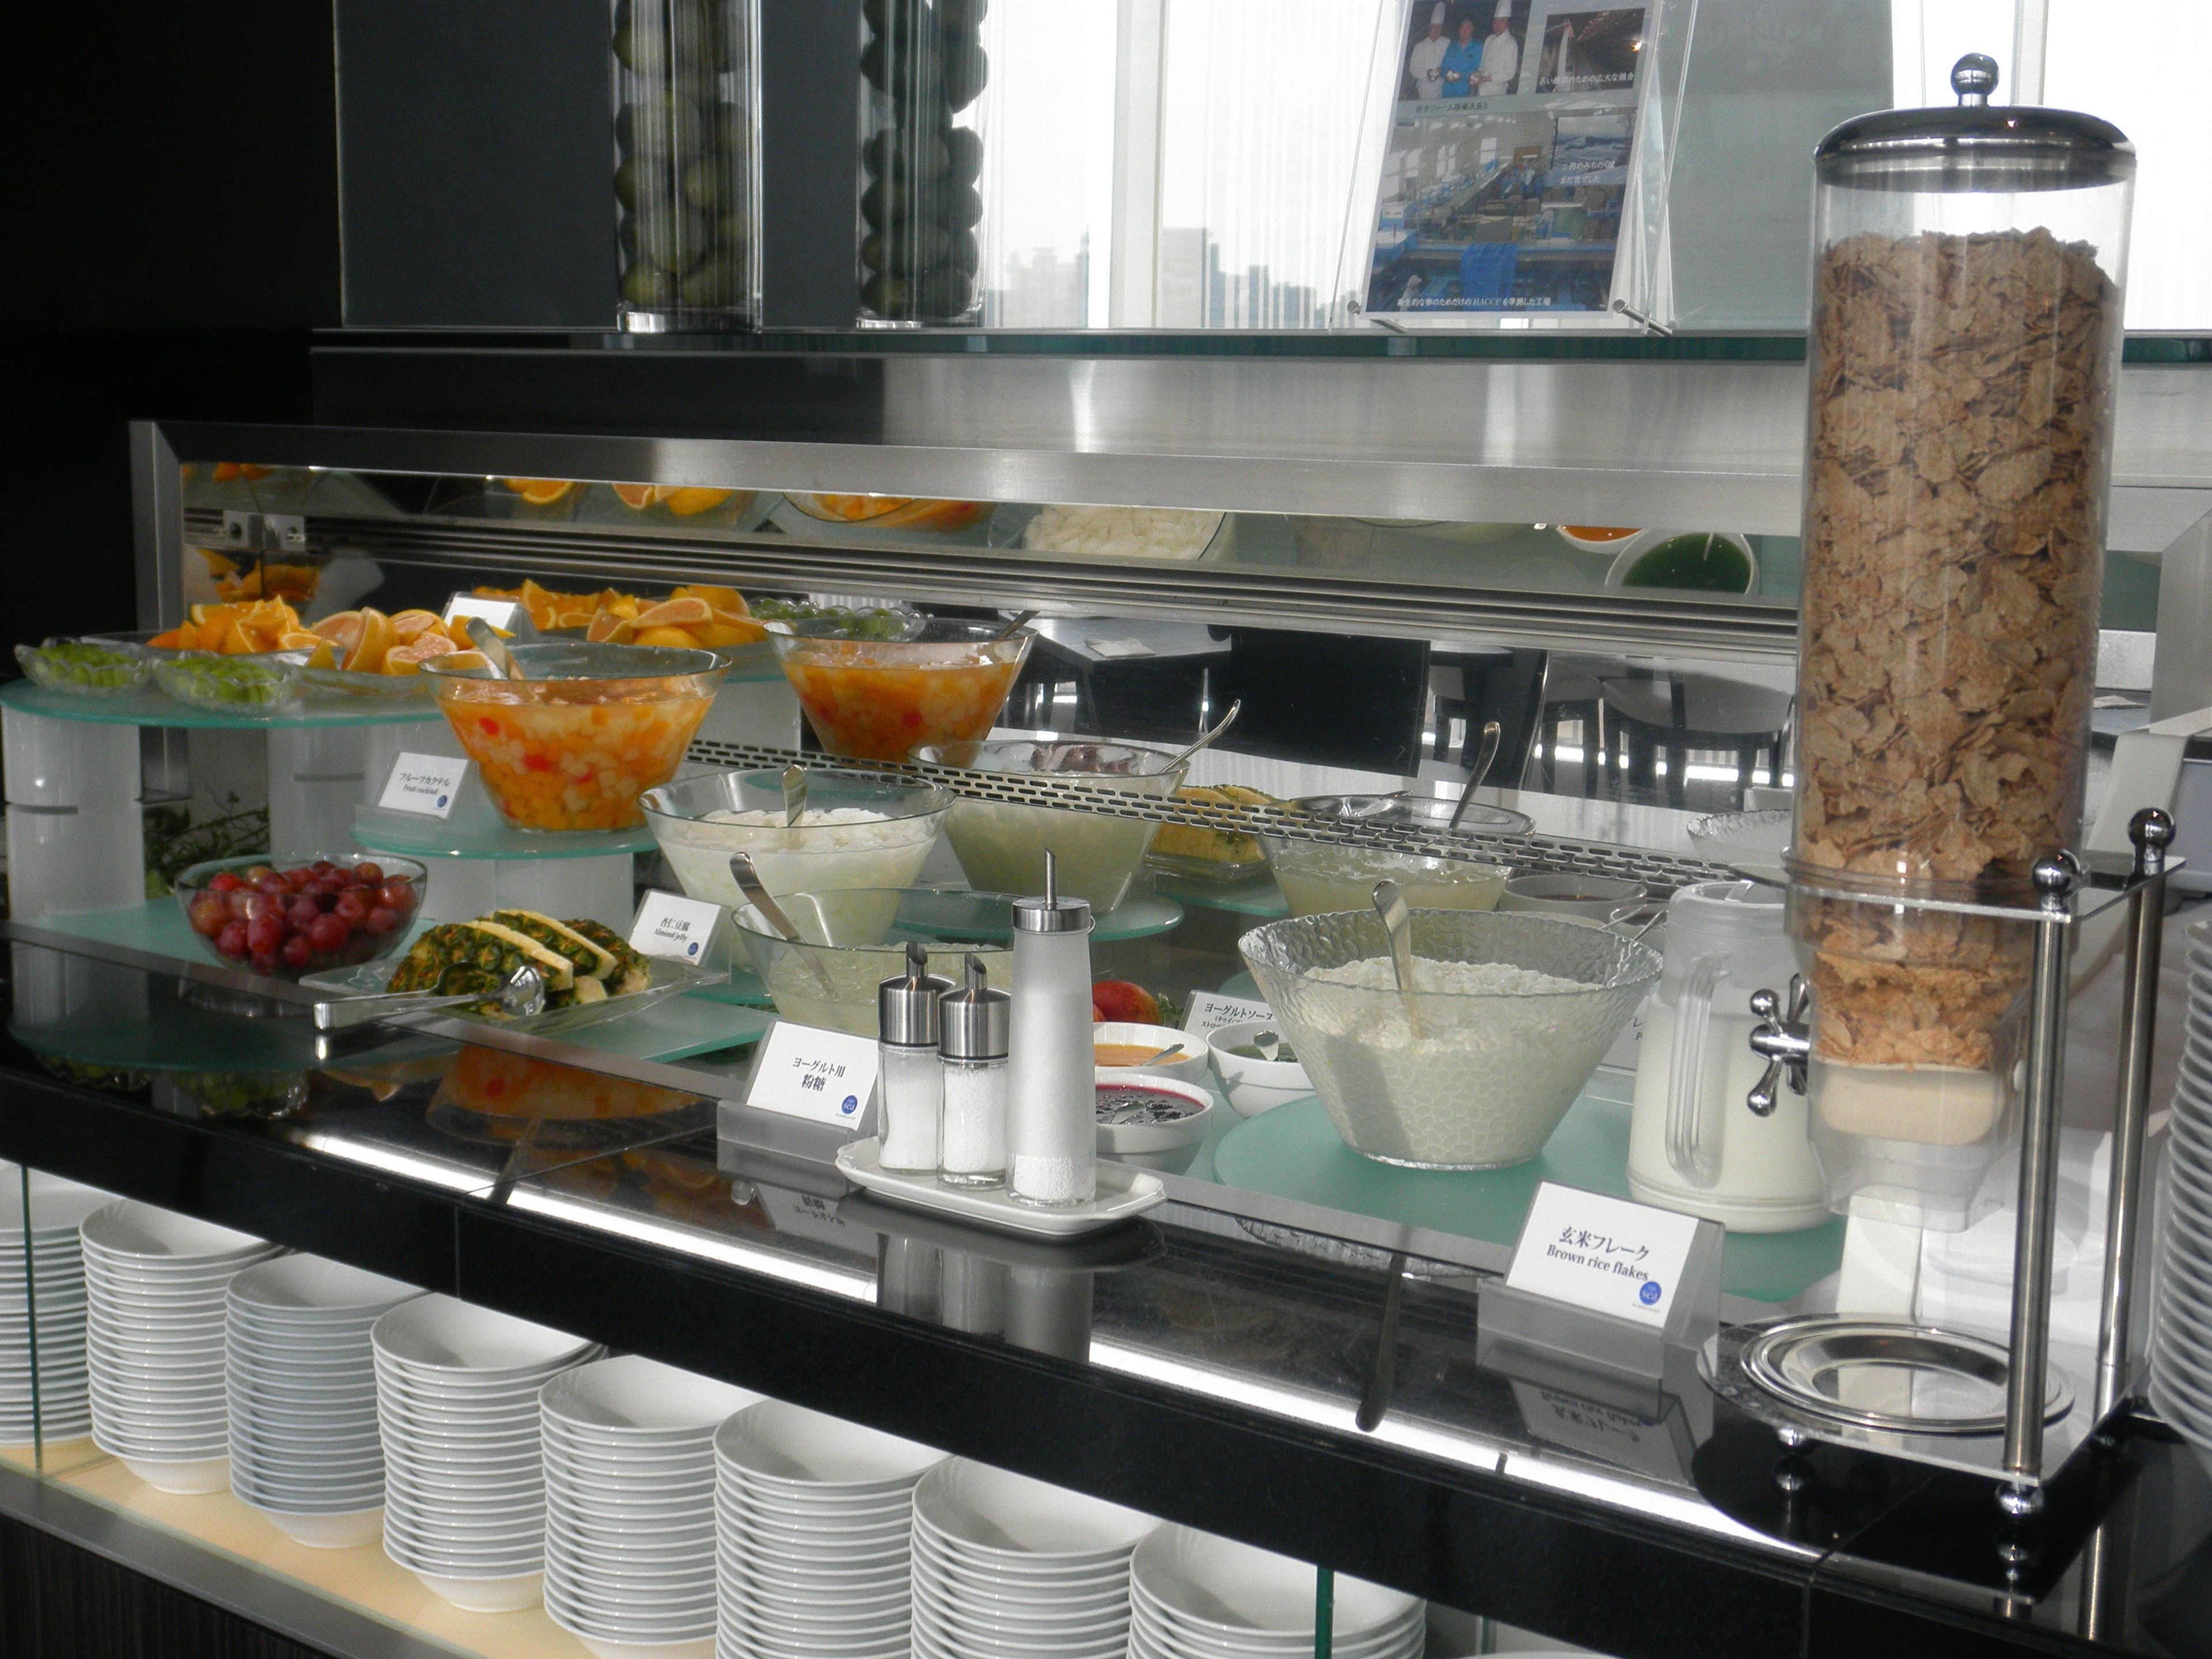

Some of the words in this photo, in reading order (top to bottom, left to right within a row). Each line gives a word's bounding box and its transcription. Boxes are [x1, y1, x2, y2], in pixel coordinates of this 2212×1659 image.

[400, 772, 450, 787] フルーツカクテル
[403, 784, 417, 793] Fruit
[653, 927, 675, 938] Almond
[673, 932, 688, 943] jelly
[1205, 1002, 1273, 1020] ヨーグルトソース
[793, 1057, 846, 1078] ヨーグルト用
[801, 1073, 827, 1092] 粉糖
[1559, 1226, 1649, 1262] 玄米フレーク
[1547, 1243, 1585, 1265] Brown
[1587, 1256, 1611, 1271] rice
[1612, 1261, 1649, 1281] flakes
